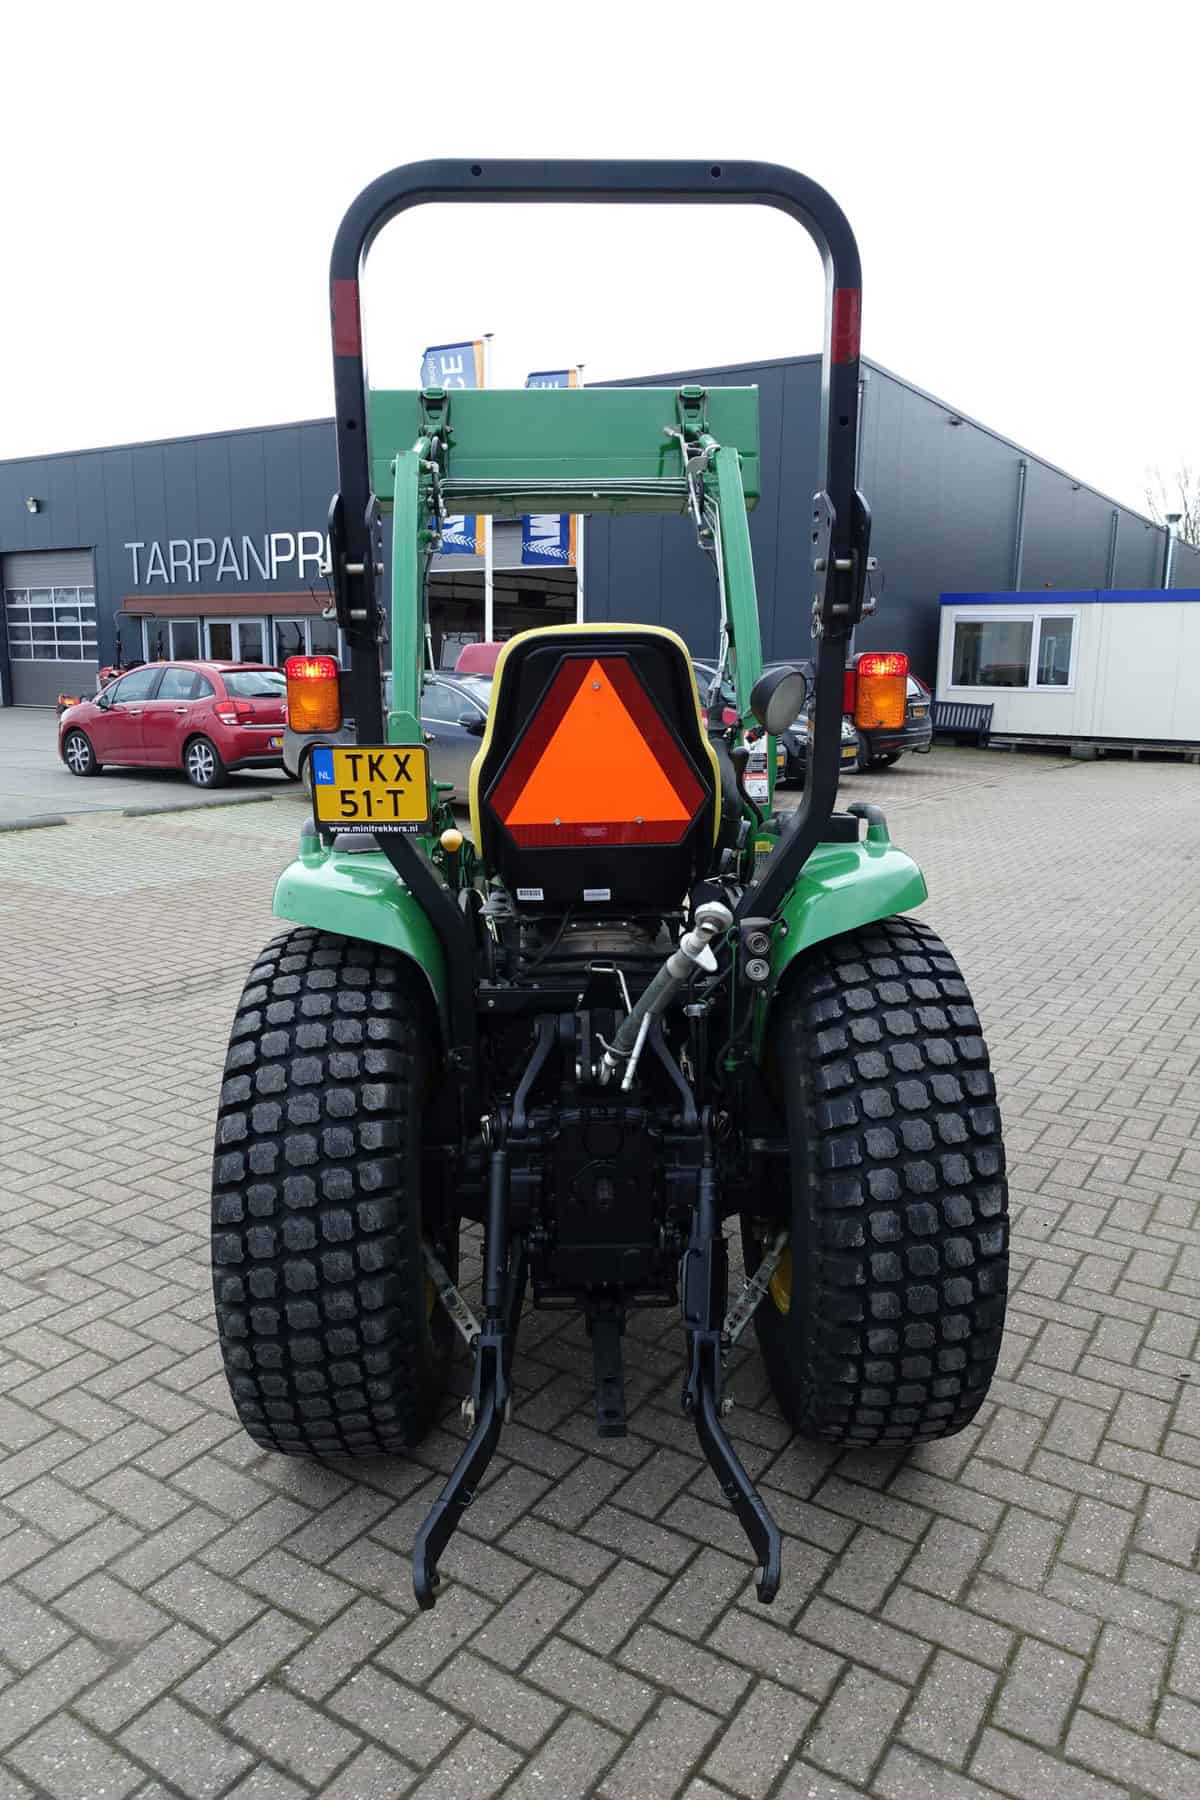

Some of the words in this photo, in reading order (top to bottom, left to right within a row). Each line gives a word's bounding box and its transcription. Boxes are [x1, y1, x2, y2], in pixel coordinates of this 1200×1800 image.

[124, 530, 333, 585] TARPANPR
[345, 753, 413, 782] TKX
[340, 789, 405, 817] 51-T
[328, 824, 418, 833] www.minitrekkers.nl
